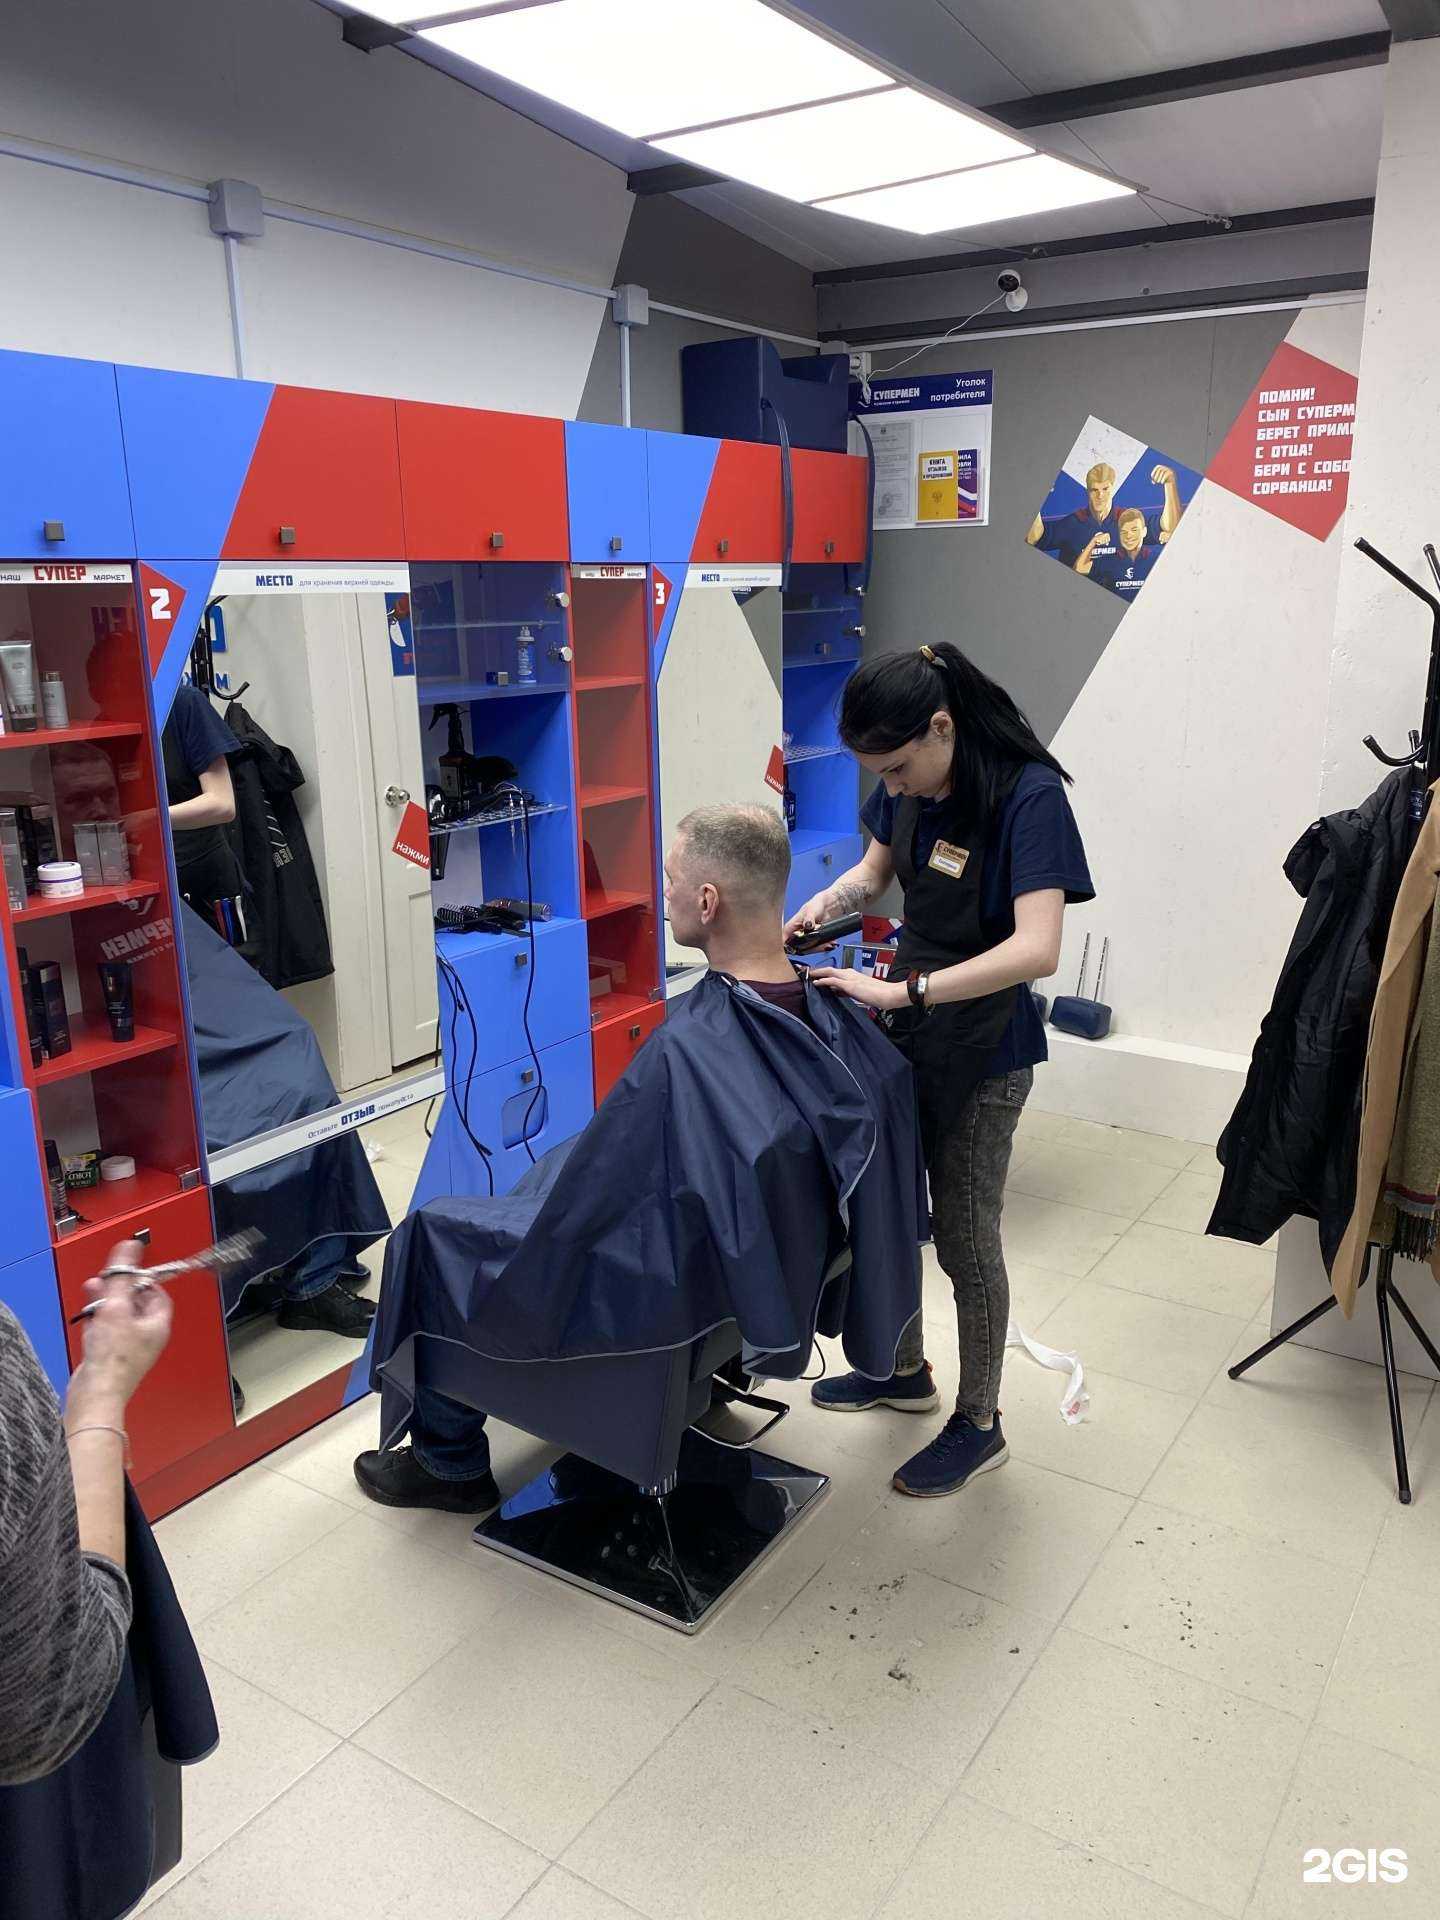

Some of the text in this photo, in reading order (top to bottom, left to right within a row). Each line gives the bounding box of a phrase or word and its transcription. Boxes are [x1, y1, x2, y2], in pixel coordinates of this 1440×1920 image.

[956, 378, 986, 388] Уголок
[873, 387, 920, 401] СУПЕРМЕН
[930, 390, 986, 403] потребителя
[1259, 387, 1316, 404] ПОМНИ!
[1258, 408, 1290, 423] СЫН
[1256, 426, 1300, 441] БЕРЕТ
[1255, 443, 1313, 459] С ОТЦА!
[1254, 462, 1290, 477] БЕРИ
[1297, 462, 1306, 475] С
[1252, 479, 1333, 495] СОРВАНЦА!
[33, 565, 87, 581] СУПЕР
[600, 566, 625, 577] СУПЕР
[701, 574, 720, 582] МЕСТО
[255, 575, 294, 587] МЕСТО
[655, 582, 665, 604] 3
[149, 588, 172, 620] 2
[396, 841, 430, 865] нажми
[307, 1123, 339, 1139] Оставьте
[340, 1104, 376, 1126] ОТЗЫВ
